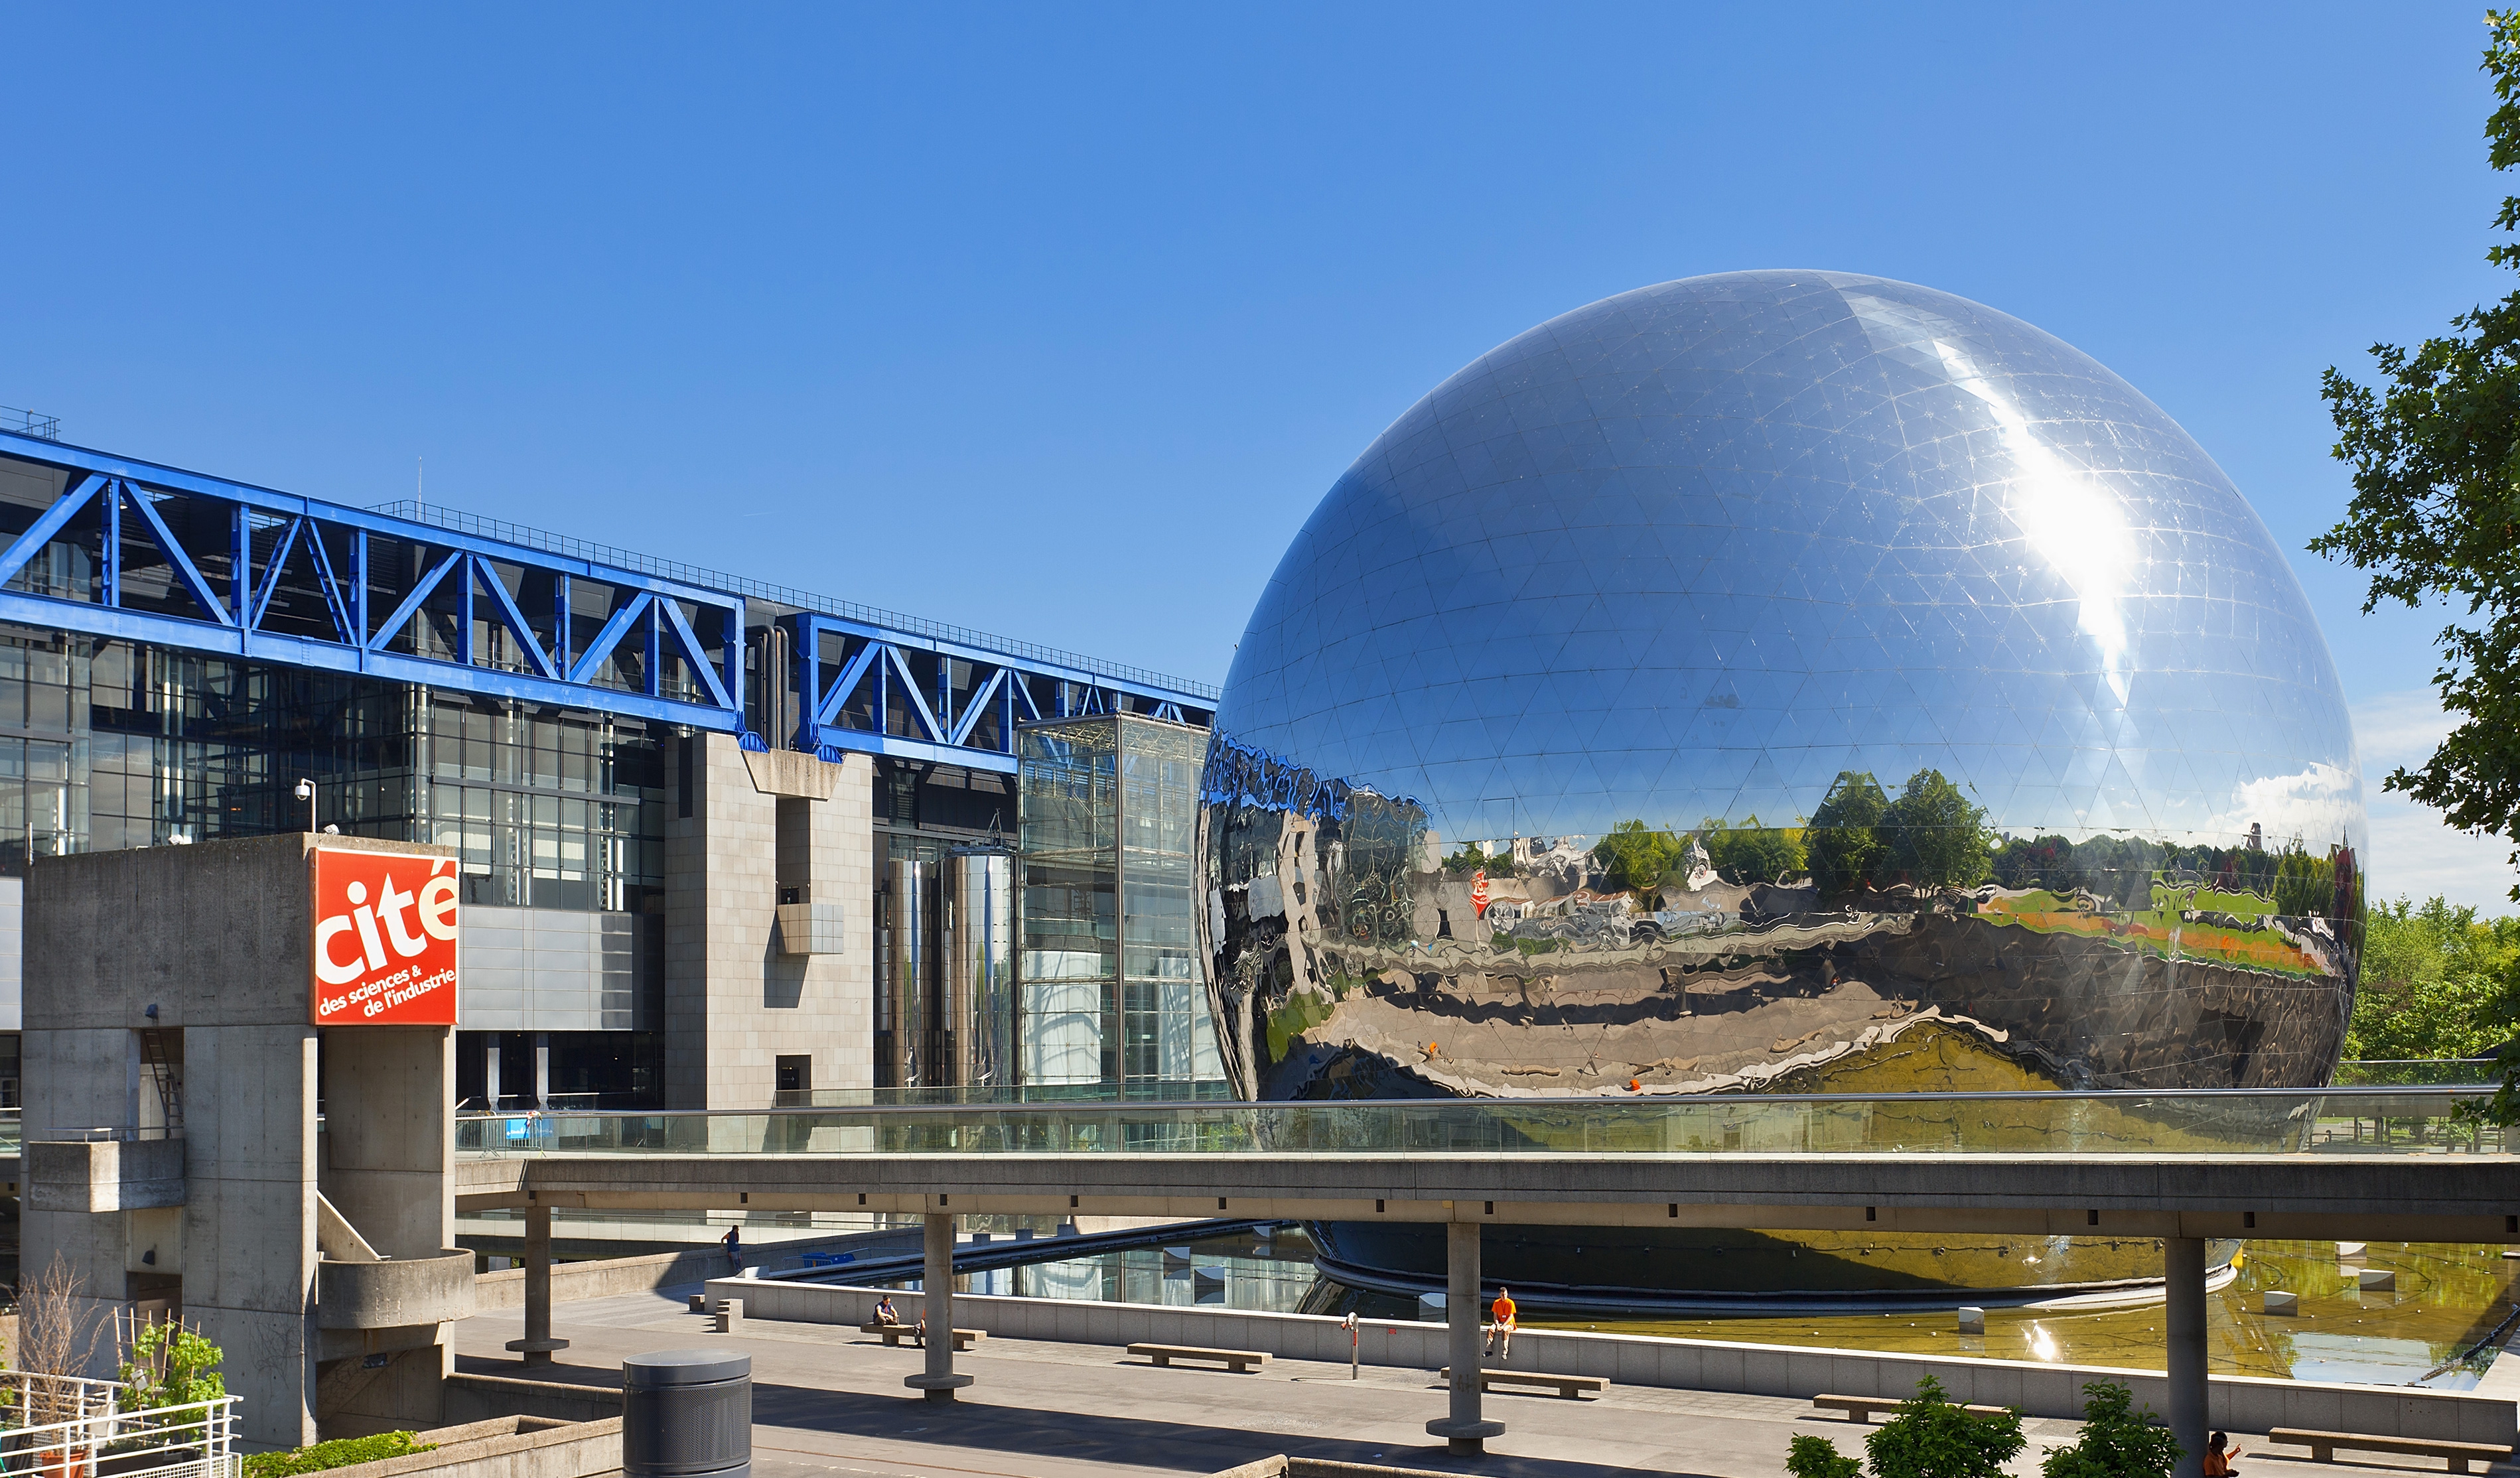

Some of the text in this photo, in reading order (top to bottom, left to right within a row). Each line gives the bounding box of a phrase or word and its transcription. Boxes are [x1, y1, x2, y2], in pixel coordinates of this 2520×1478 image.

[315, 860, 458, 984] cité
[319, 965, 422, 1016] des sciences &
[364, 968, 456, 1017] de l'industrie
